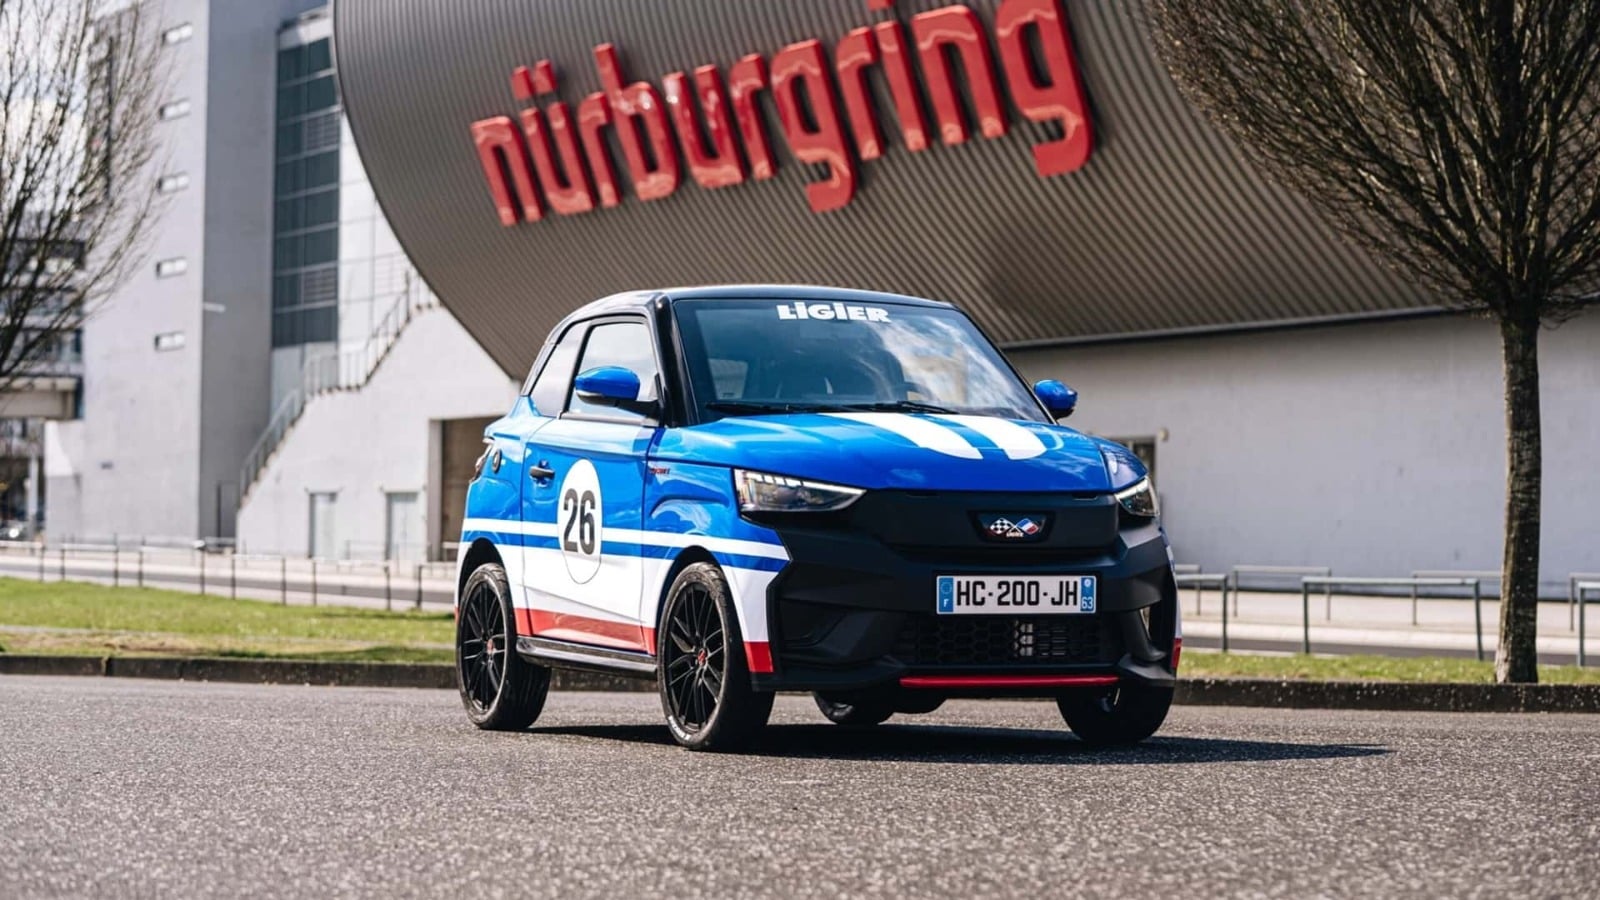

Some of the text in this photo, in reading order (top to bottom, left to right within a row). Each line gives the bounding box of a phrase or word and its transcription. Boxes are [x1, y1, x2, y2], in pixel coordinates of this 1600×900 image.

[471, 0, 1094, 226] nürburgring
[563, 488, 596, 555] 26
[956, 580, 1078, 606] HC-200-JH
[1081, 596, 1094, 609] 63
